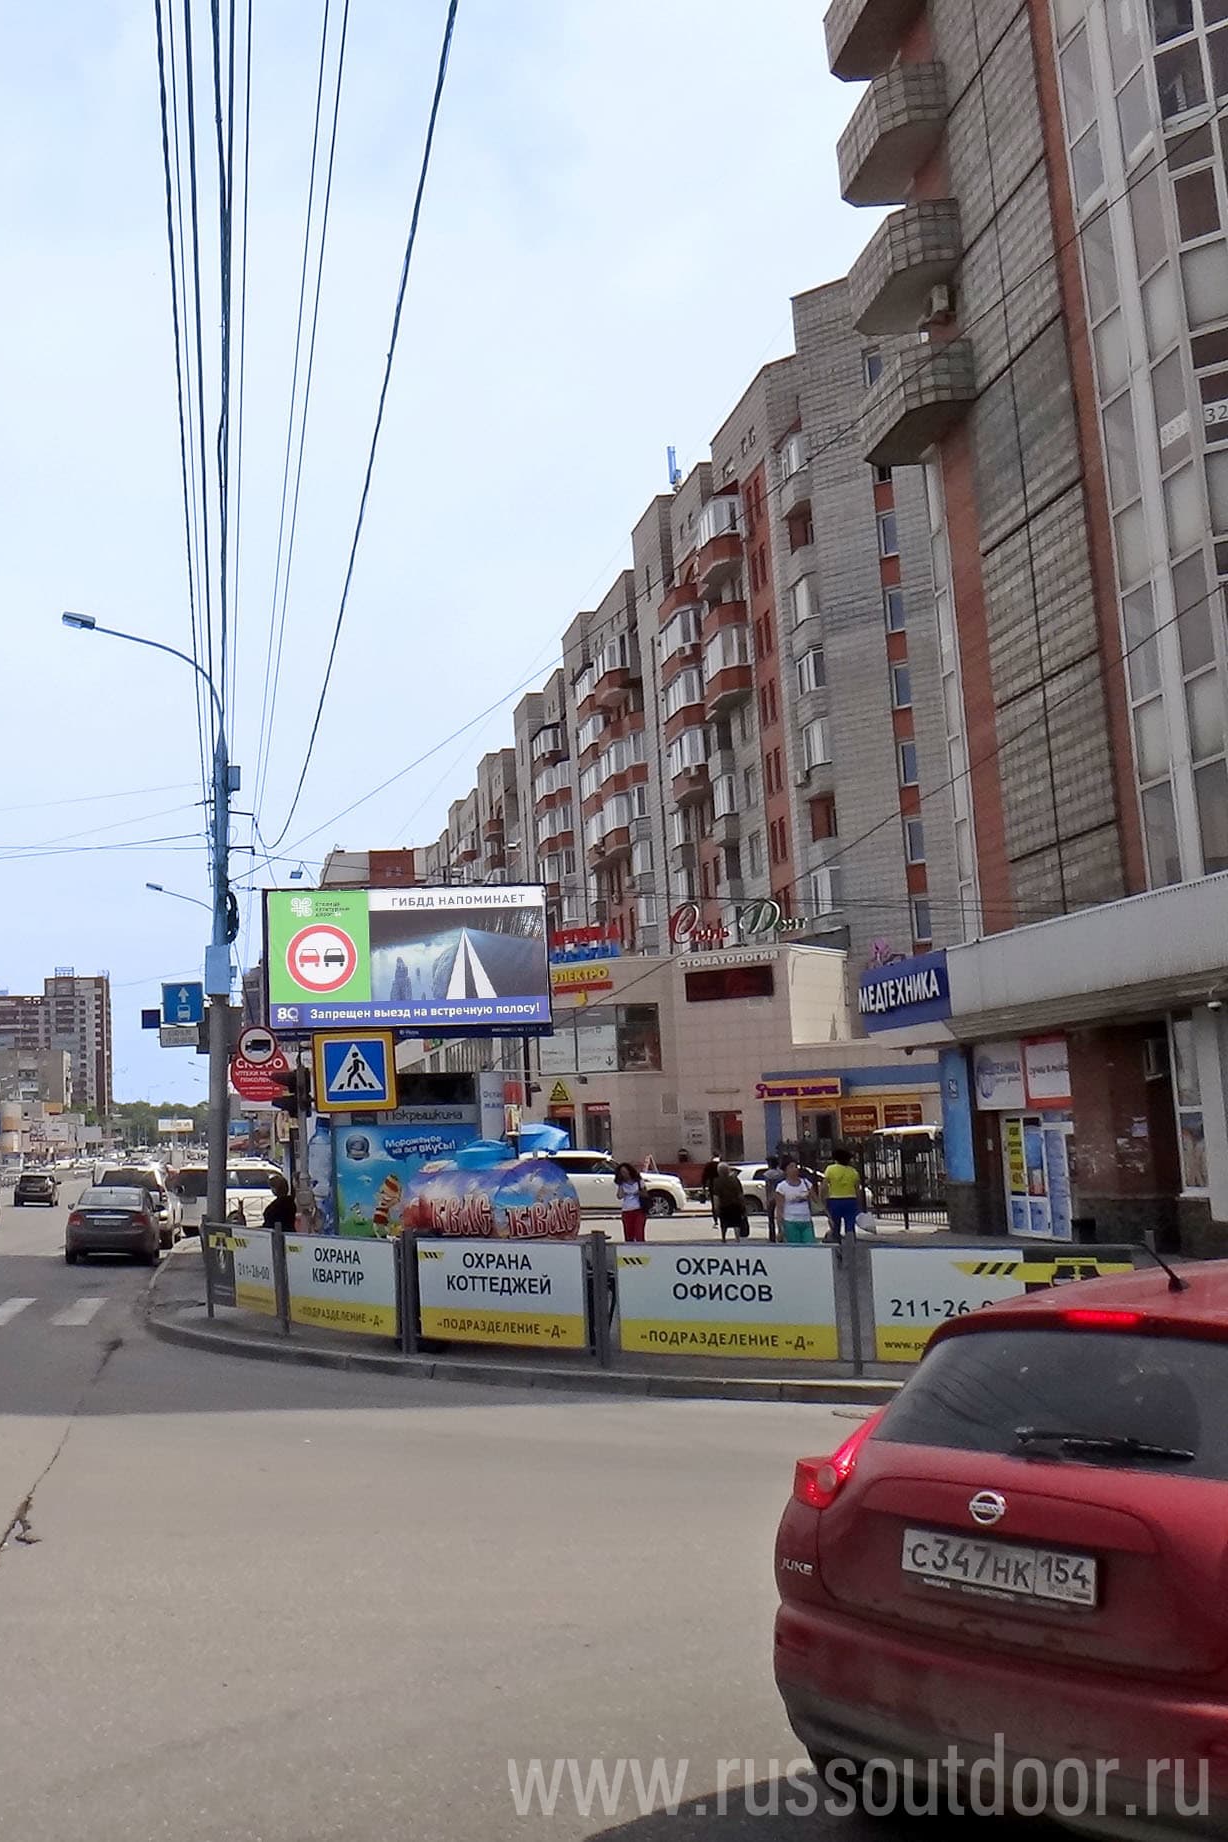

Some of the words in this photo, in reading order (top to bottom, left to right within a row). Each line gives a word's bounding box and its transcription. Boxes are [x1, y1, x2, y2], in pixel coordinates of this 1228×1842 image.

[391, 897, 435, 908] ГИБДД
[438, 894, 526, 905] НАПОМИНАЕТ
[677, 950, 780, 968] СТОМАТОЛОГИЯ
[551, 967, 609, 984] ЭЛЕКТРО
[858, 968, 940, 1013] МЕДТЕХНИКА
[310, 1008, 371, 1021] Запрещен
[374, 1007, 411, 1019] выезд
[414, 1007, 428, 1017] на
[431, 1005, 493, 1017] встречную
[496, 1001, 540, 1014] полосу!
[385, 1109, 463, 1122] Покрышкина
[430, 1194, 493, 1236] КВАС
[506, 1199, 580, 1239] КВАС
[314, 1247, 361, 1265] ОХРАНА
[462, 1252, 532, 1270] ОХРАНА
[312, 1267, 364, 1286] КВАРТИР
[676, 1257, 768, 1277] ОХРАНА
[447, 1274, 552, 1296] КОТТЕДЖЕЙ
[673, 1283, 773, 1302] ОФИСОВ
[640, 1330, 779, 1347] «ПОДРАЗДЕЛЕНИЕ
[780, 1557, 813, 1576] JUKE
[1040, 1555, 1092, 1589] 154
